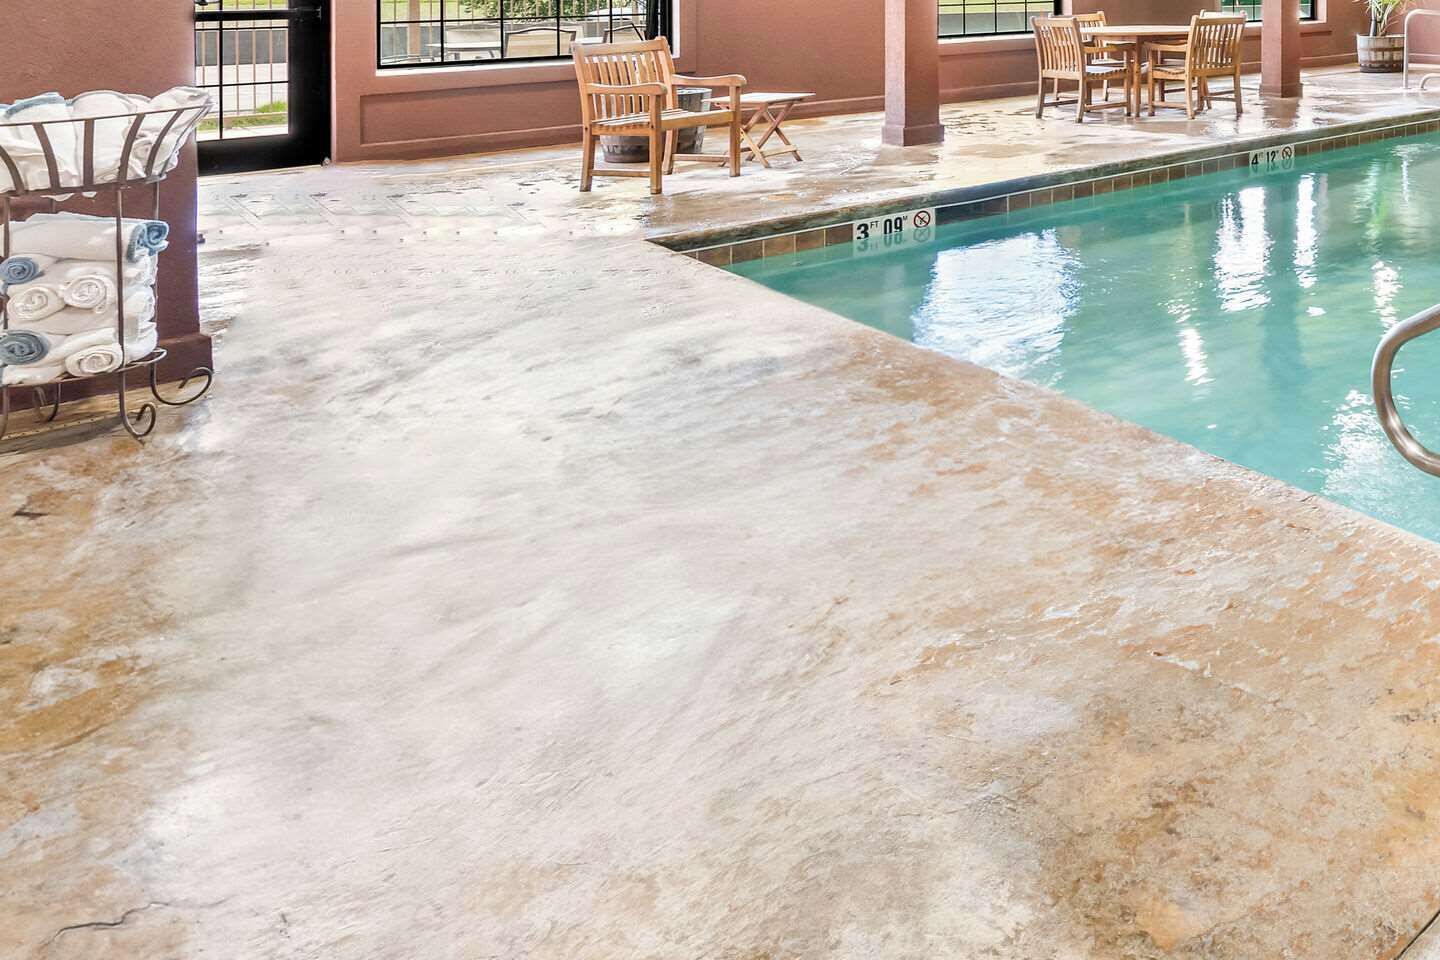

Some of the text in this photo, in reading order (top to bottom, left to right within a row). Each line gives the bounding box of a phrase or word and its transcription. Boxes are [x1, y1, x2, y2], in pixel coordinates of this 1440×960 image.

[1251, 153, 1259, 165] 4
[856, 223, 869, 240] 3
[870, 220, 880, 229] FT
